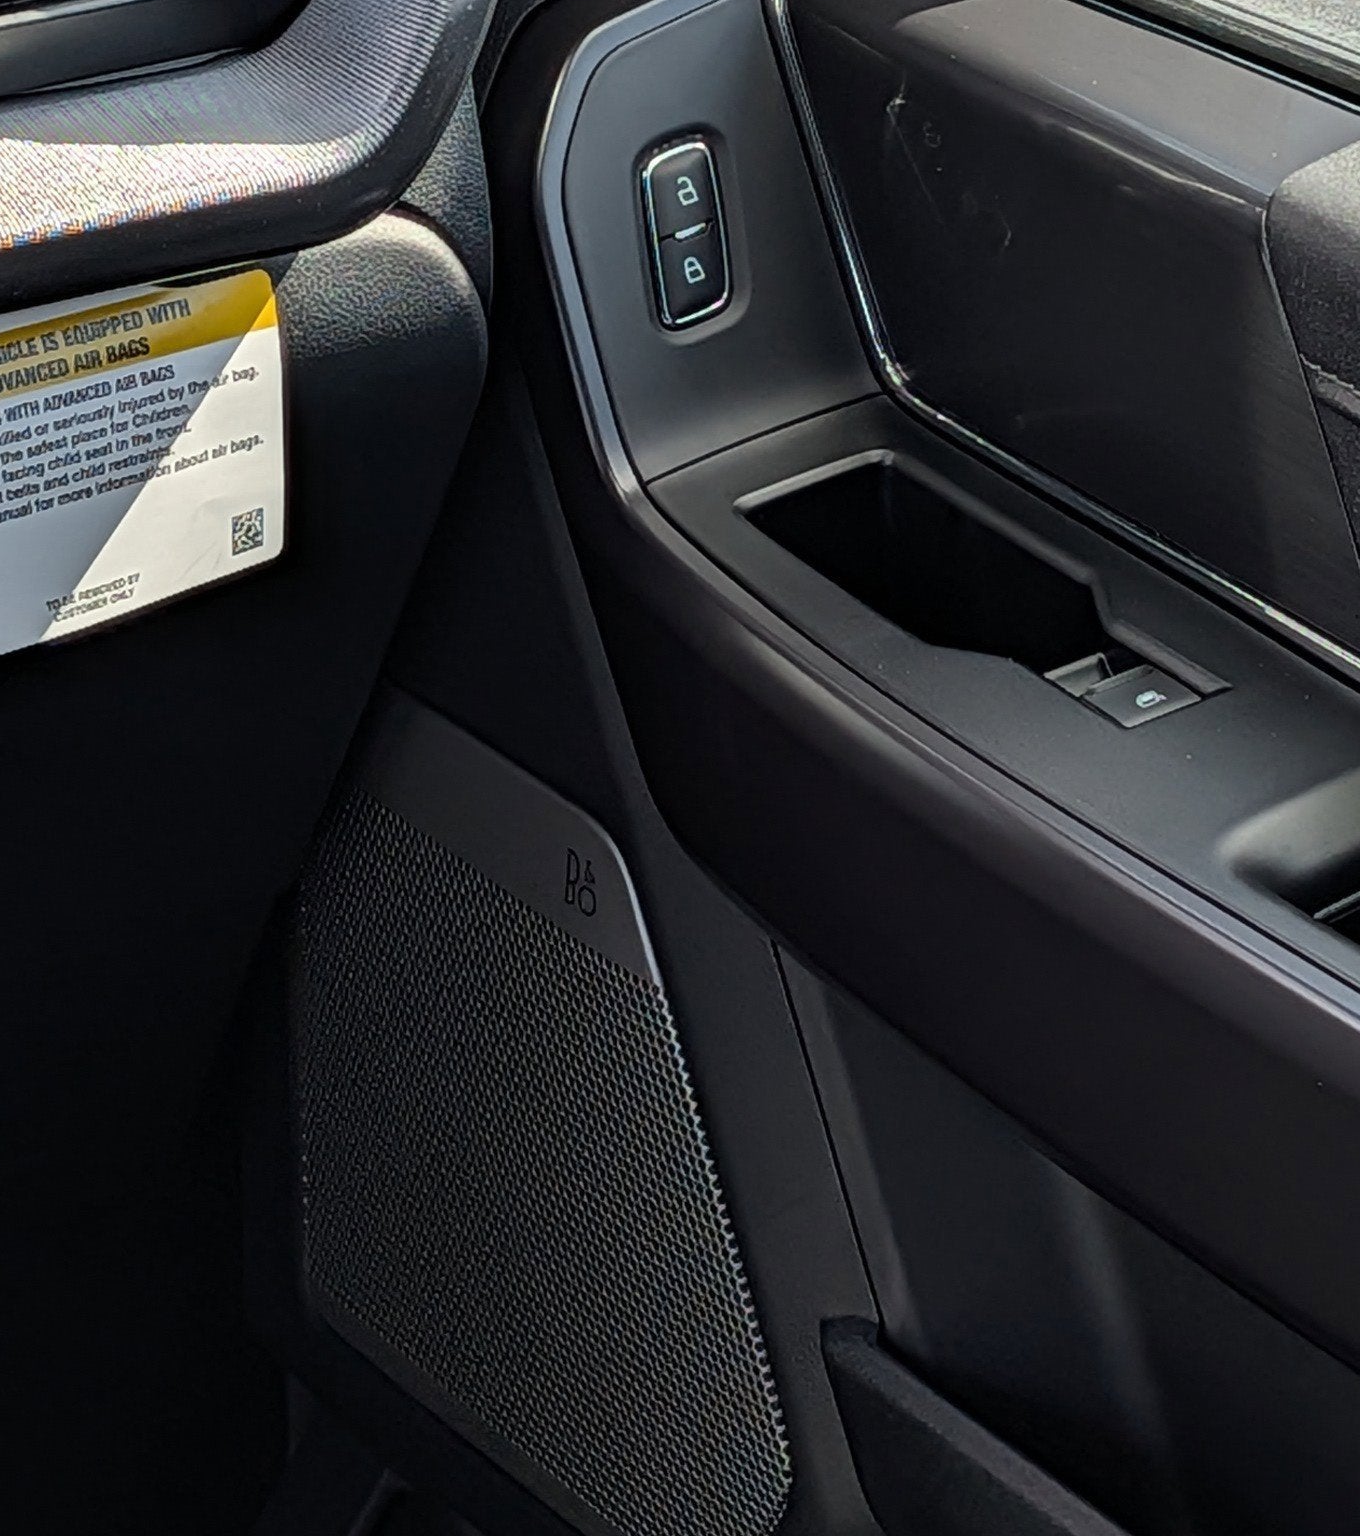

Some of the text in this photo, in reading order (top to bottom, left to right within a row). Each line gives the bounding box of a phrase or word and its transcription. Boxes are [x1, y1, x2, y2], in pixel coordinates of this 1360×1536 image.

[40, 330, 59, 354] IS
[61, 310, 143, 346] EQUIPPED
[146, 298, 191, 325] WITH
[73, 349, 102, 373] AIR
[105, 336, 150, 364] BAGS
[3, 399, 40, 422] WITH
[42, 381, 112, 413] ADVANCED
[114, 373, 137, 394] AIR
[139, 364, 175, 386] BAGS
[33, 422, 49, 437] or
[52, 404, 115, 431] seriously
[117, 388, 165, 414] injured
[167, 385, 185, 401] by
[187, 379, 209, 395] the
[0, 449, 24, 466] the
[26, 435, 68, 459] safest
[70, 427, 108, 449] place
[110, 420, 129, 435] for
[1, 462, 45, 483] facing
[47, 449, 82, 471] child
[83, 441, 113, 461] seat
[115, 438, 129, 452] in
[130, 432, 153, 447] the
[5, 483, 40, 501] belts
[43, 472, 70, 492] and
[71, 461, 106, 483] child
[33, 496, 55, 513] for
[57, 486, 94, 505] more
[174, 449, 209, 472] about
